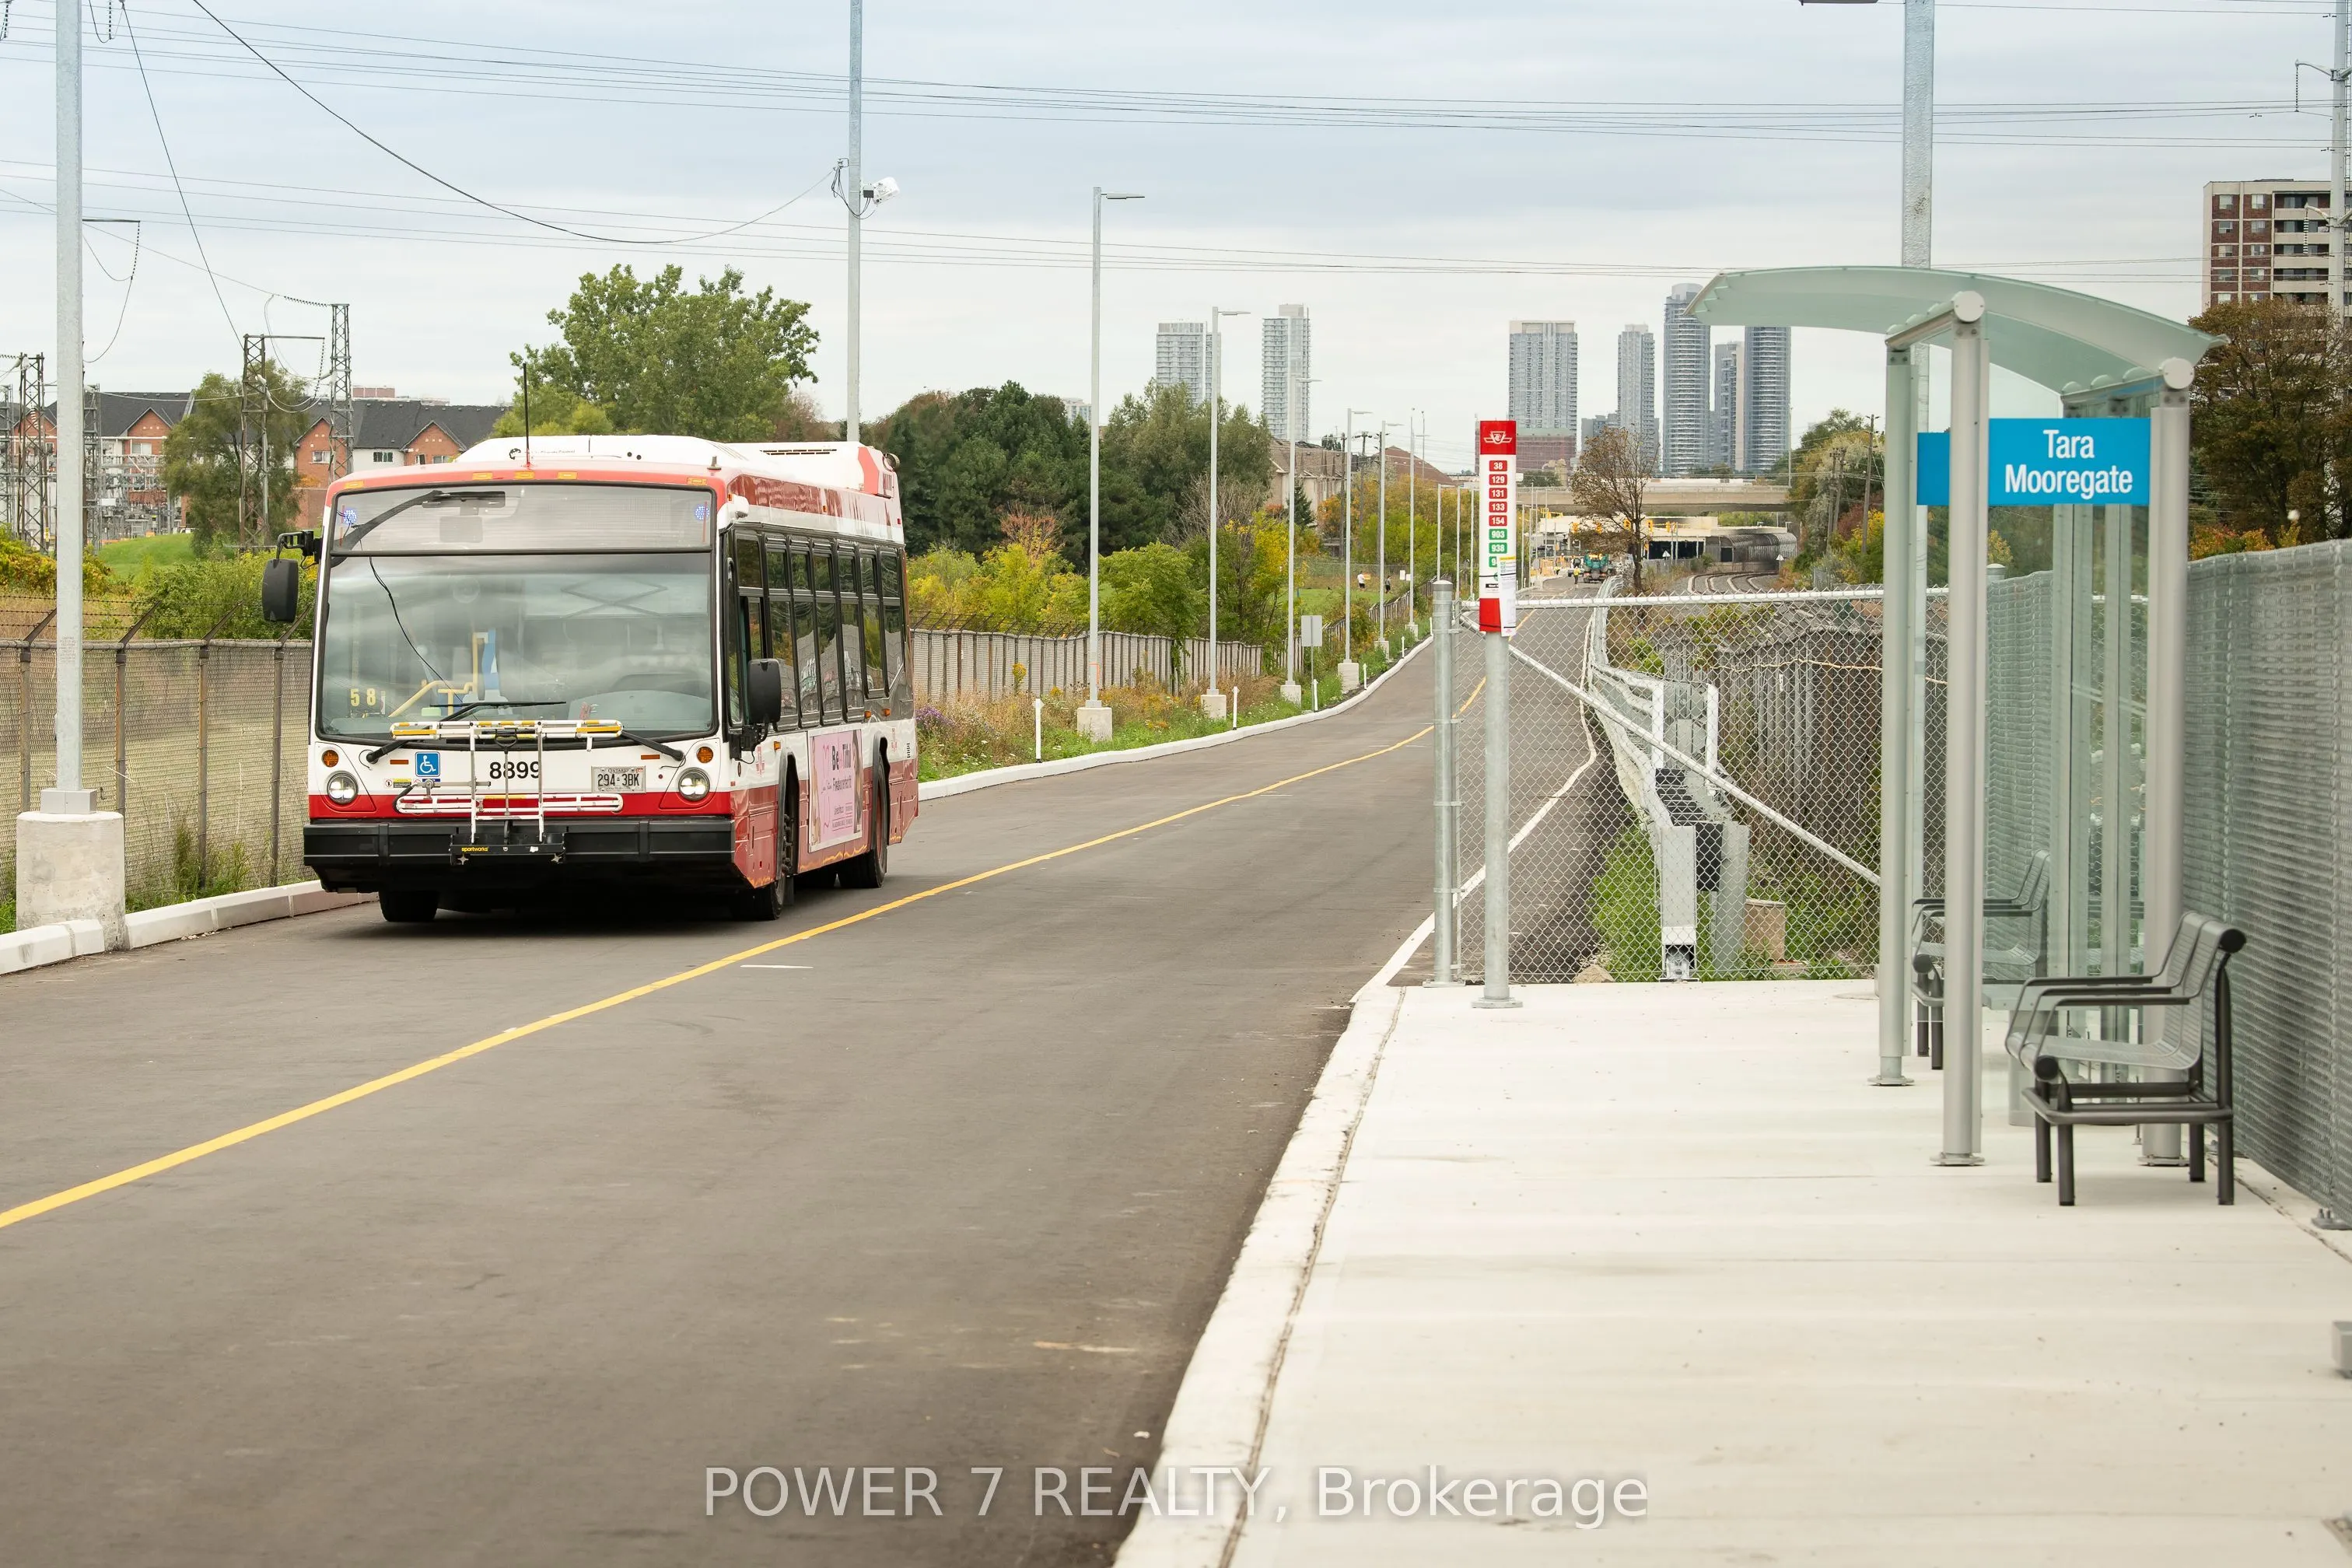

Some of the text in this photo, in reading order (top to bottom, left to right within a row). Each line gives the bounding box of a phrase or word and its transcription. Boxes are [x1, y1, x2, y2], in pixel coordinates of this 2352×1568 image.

[2043, 429, 2095, 459] Tara
[1491, 489, 1505, 498] 131
[2004, 464, 2133, 500] Mooregate
[489, 761, 539, 779] 8899
